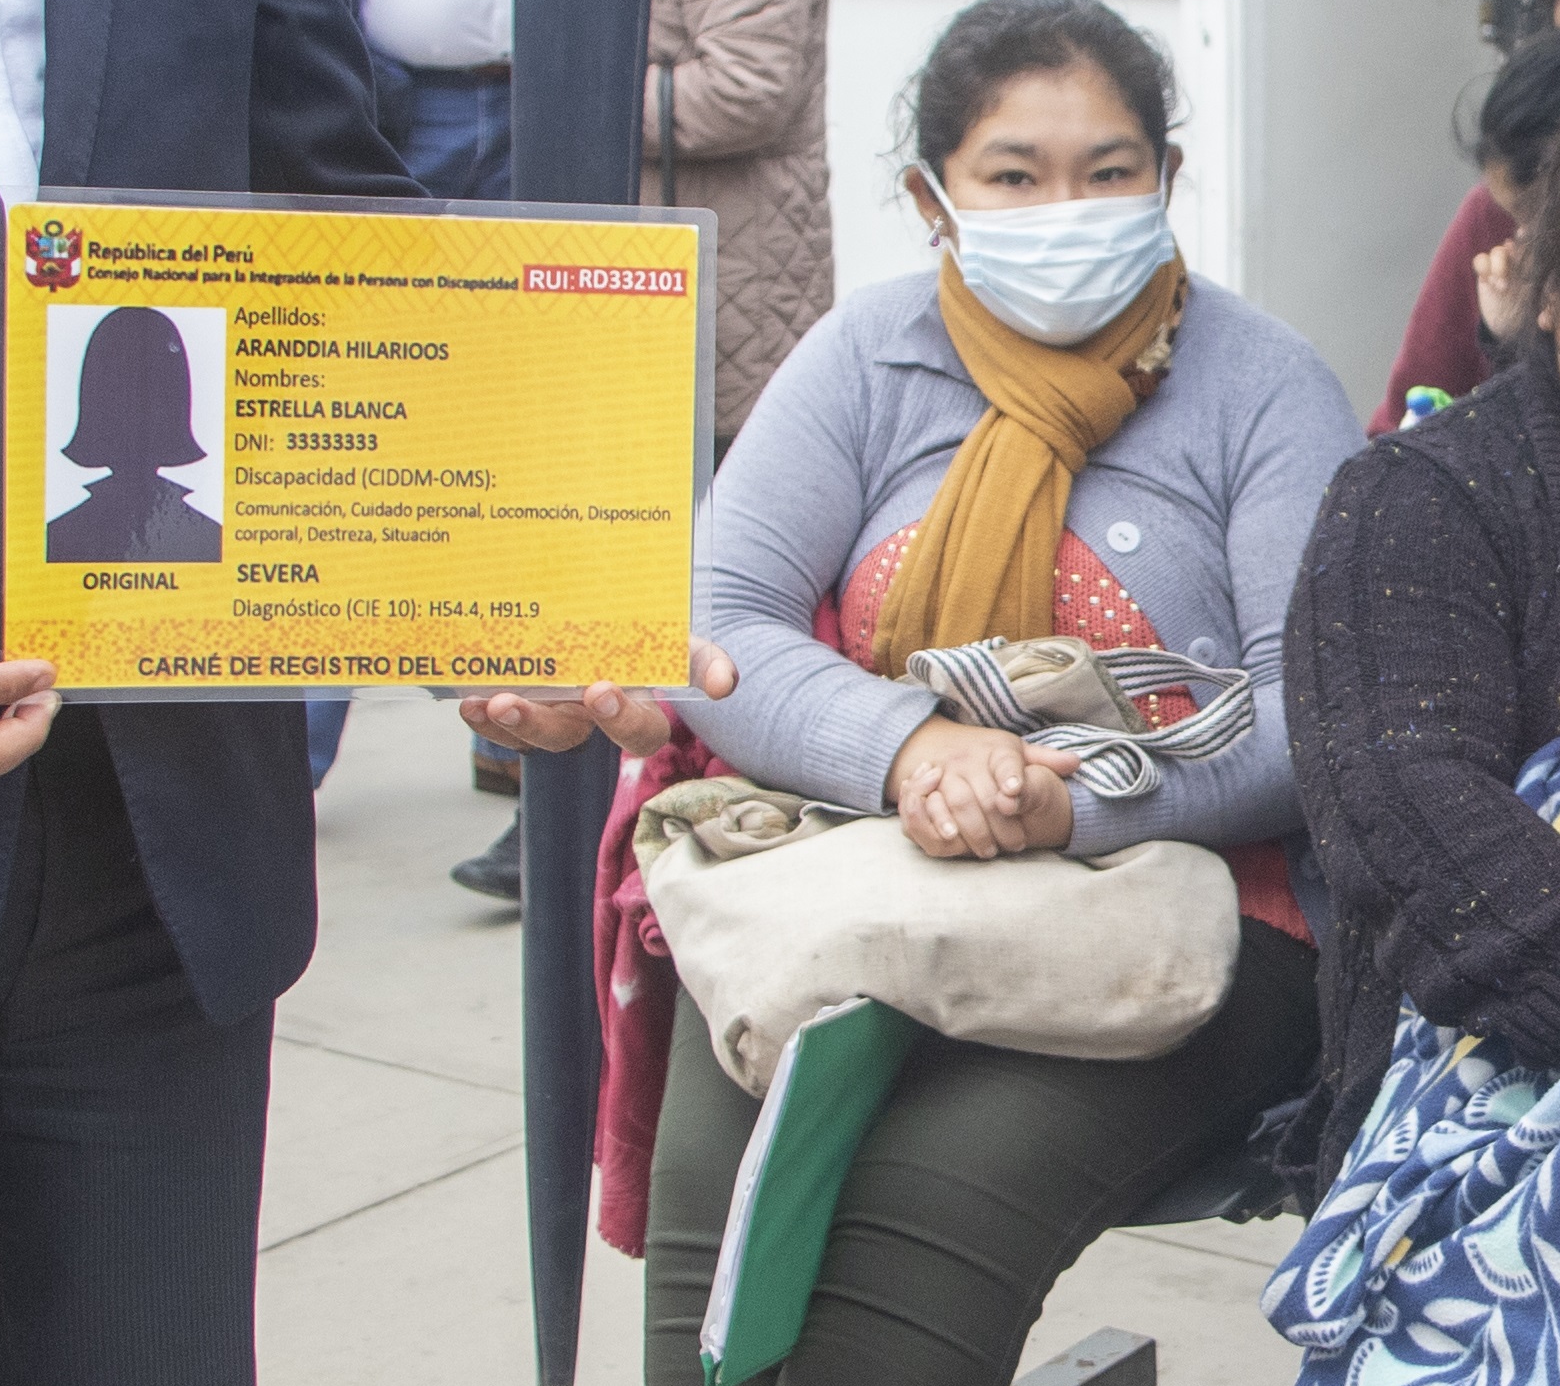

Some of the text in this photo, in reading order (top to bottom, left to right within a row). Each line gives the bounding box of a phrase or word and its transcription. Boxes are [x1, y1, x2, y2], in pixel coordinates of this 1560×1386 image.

[88, 241, 254, 264] República del Perú
[87, 266, 519, 292] Consejo Nacional para la Integración de la Persona con Discapacidad
[234, 306, 326, 329] Apellidos:
[236, 339, 449, 360] ARANDDIA HILARIOOS
[234, 368, 325, 388] Nombres:
[235, 399, 407, 419] ESTRELLA BLANCA
[234, 432, 378, 452] DNI: 33333333
[235, 466, 497, 490] Discapacidad (CIDDM-OMS):
[235, 500, 671, 524] Comunicación, Cuidado personal, Locomoción, Disposición
[234, 526, 450, 546] corporal, Destreza, Situación
[82, 572, 179, 590] ORIGINAL
[237, 563, 320, 583] SEVERA
[233, 598, 540, 622] Diagnóstico (CIE 10): H54.4, H91.9
[138, 652, 557, 677] CARNÉ DE REGISTRO DEL CONADIS
